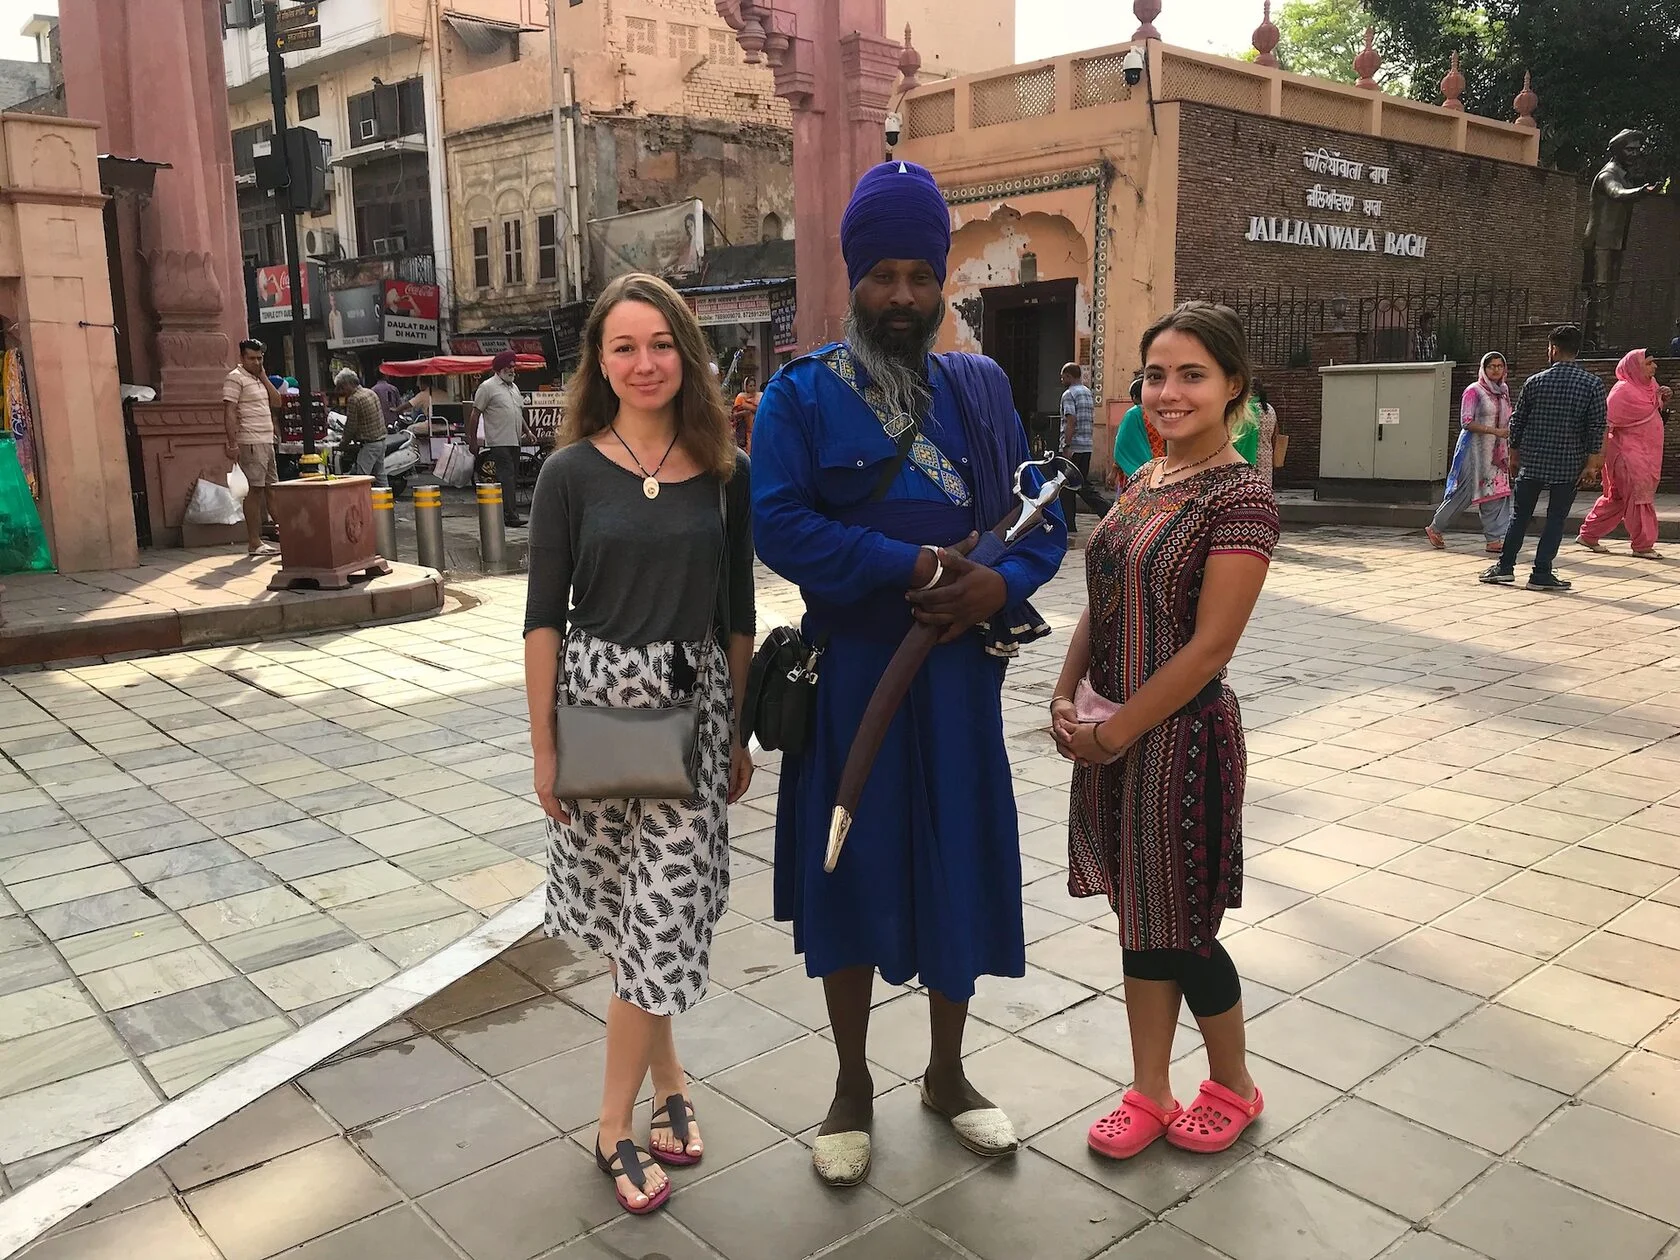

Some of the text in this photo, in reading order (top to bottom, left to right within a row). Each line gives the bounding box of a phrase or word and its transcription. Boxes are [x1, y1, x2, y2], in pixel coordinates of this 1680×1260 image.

[1368, 166, 1390, 185] बाग
[1362, 200, 1383, 217] ਬਾਗ
[1245, 216, 1428, 258] JALLIANWALA BAGH
[405, 283, 435, 297] Coca-Cola
[387, 321, 436, 332] DAULAT RAM
[404, 331, 427, 339] HATTI
